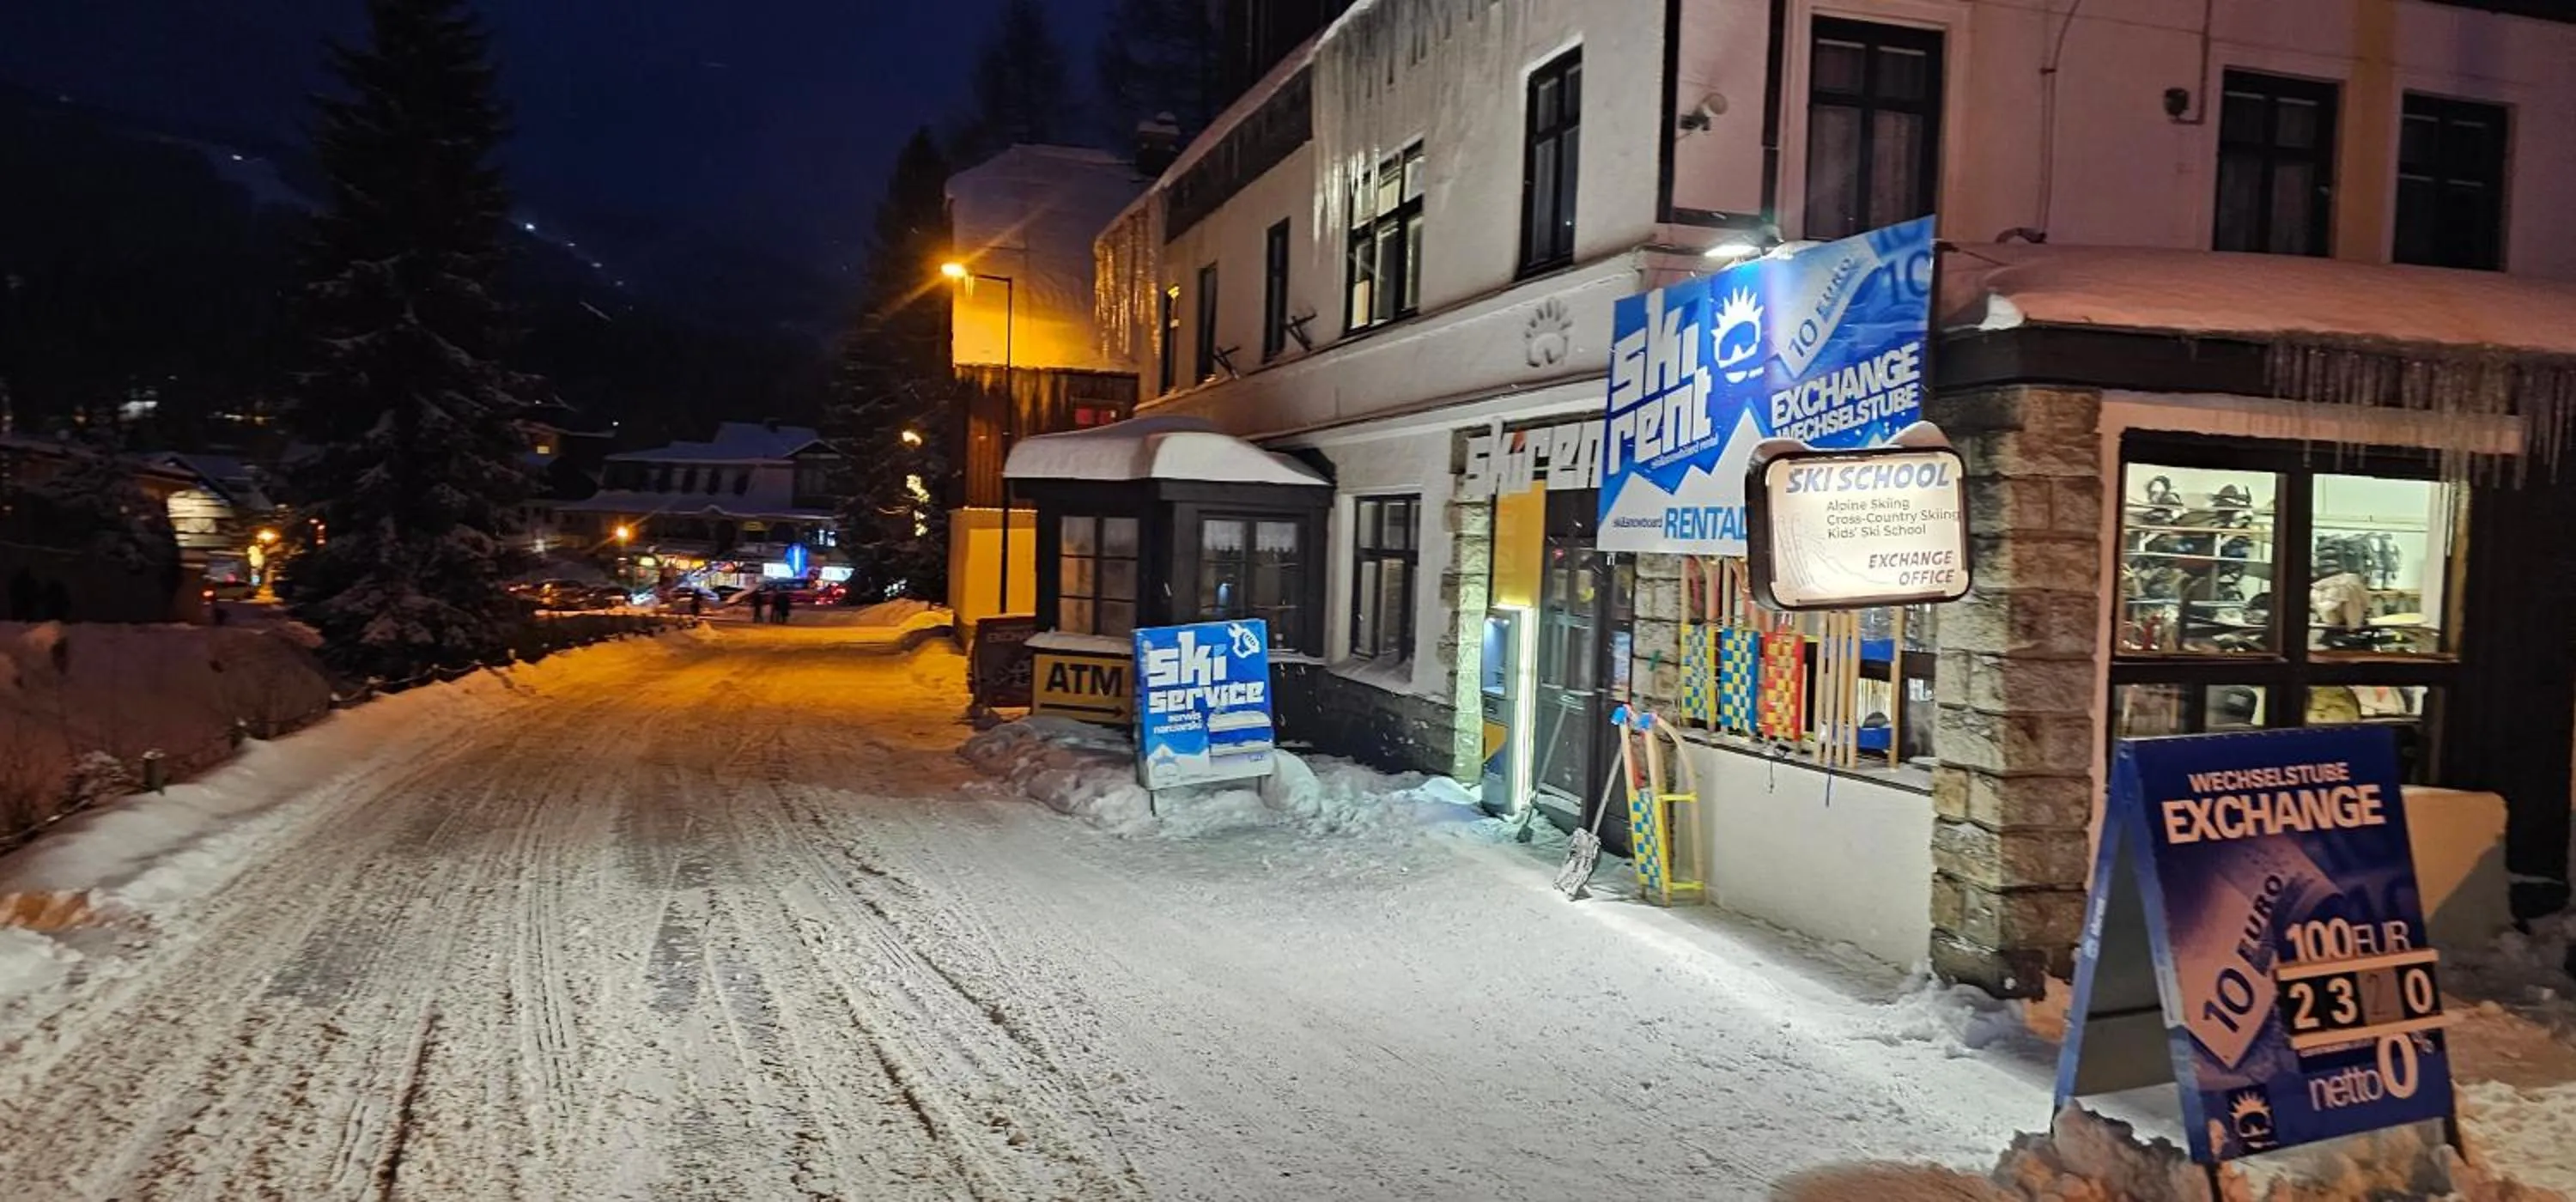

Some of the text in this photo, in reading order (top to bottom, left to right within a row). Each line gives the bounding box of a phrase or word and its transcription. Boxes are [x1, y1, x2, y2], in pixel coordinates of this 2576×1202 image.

[1611, 288, 1699, 413] ski
[1789, 319, 1818, 357] 10
[1771, 342, 1920, 428] EXCHANGE
[1607, 366, 1712, 476] rent
[1456, 416, 1606, 501] skiren
[1786, 463, 1949, 493] SKI SCHOOL
[1826, 497, 1910, 514] Alpine Skiing
[1826, 513, 1917, 526] Cross-Country
[1827, 524, 1926, 539] Kids' Ski School
[1868, 551, 1953, 568] EXCHANGE
[1898, 569, 1955, 586] OFFICE
[1147, 630, 1227, 688] ski
[1043, 662, 1125, 698] ATM
[1148, 681, 1265, 714] service
[2187, 762, 2351, 793] WECHSELSTUBE
[2161, 783, 2387, 845] EXCHANGE
[2203, 874, 2282, 1033] 10 EURO
[2308, 1065, 2385, 1112] netto
